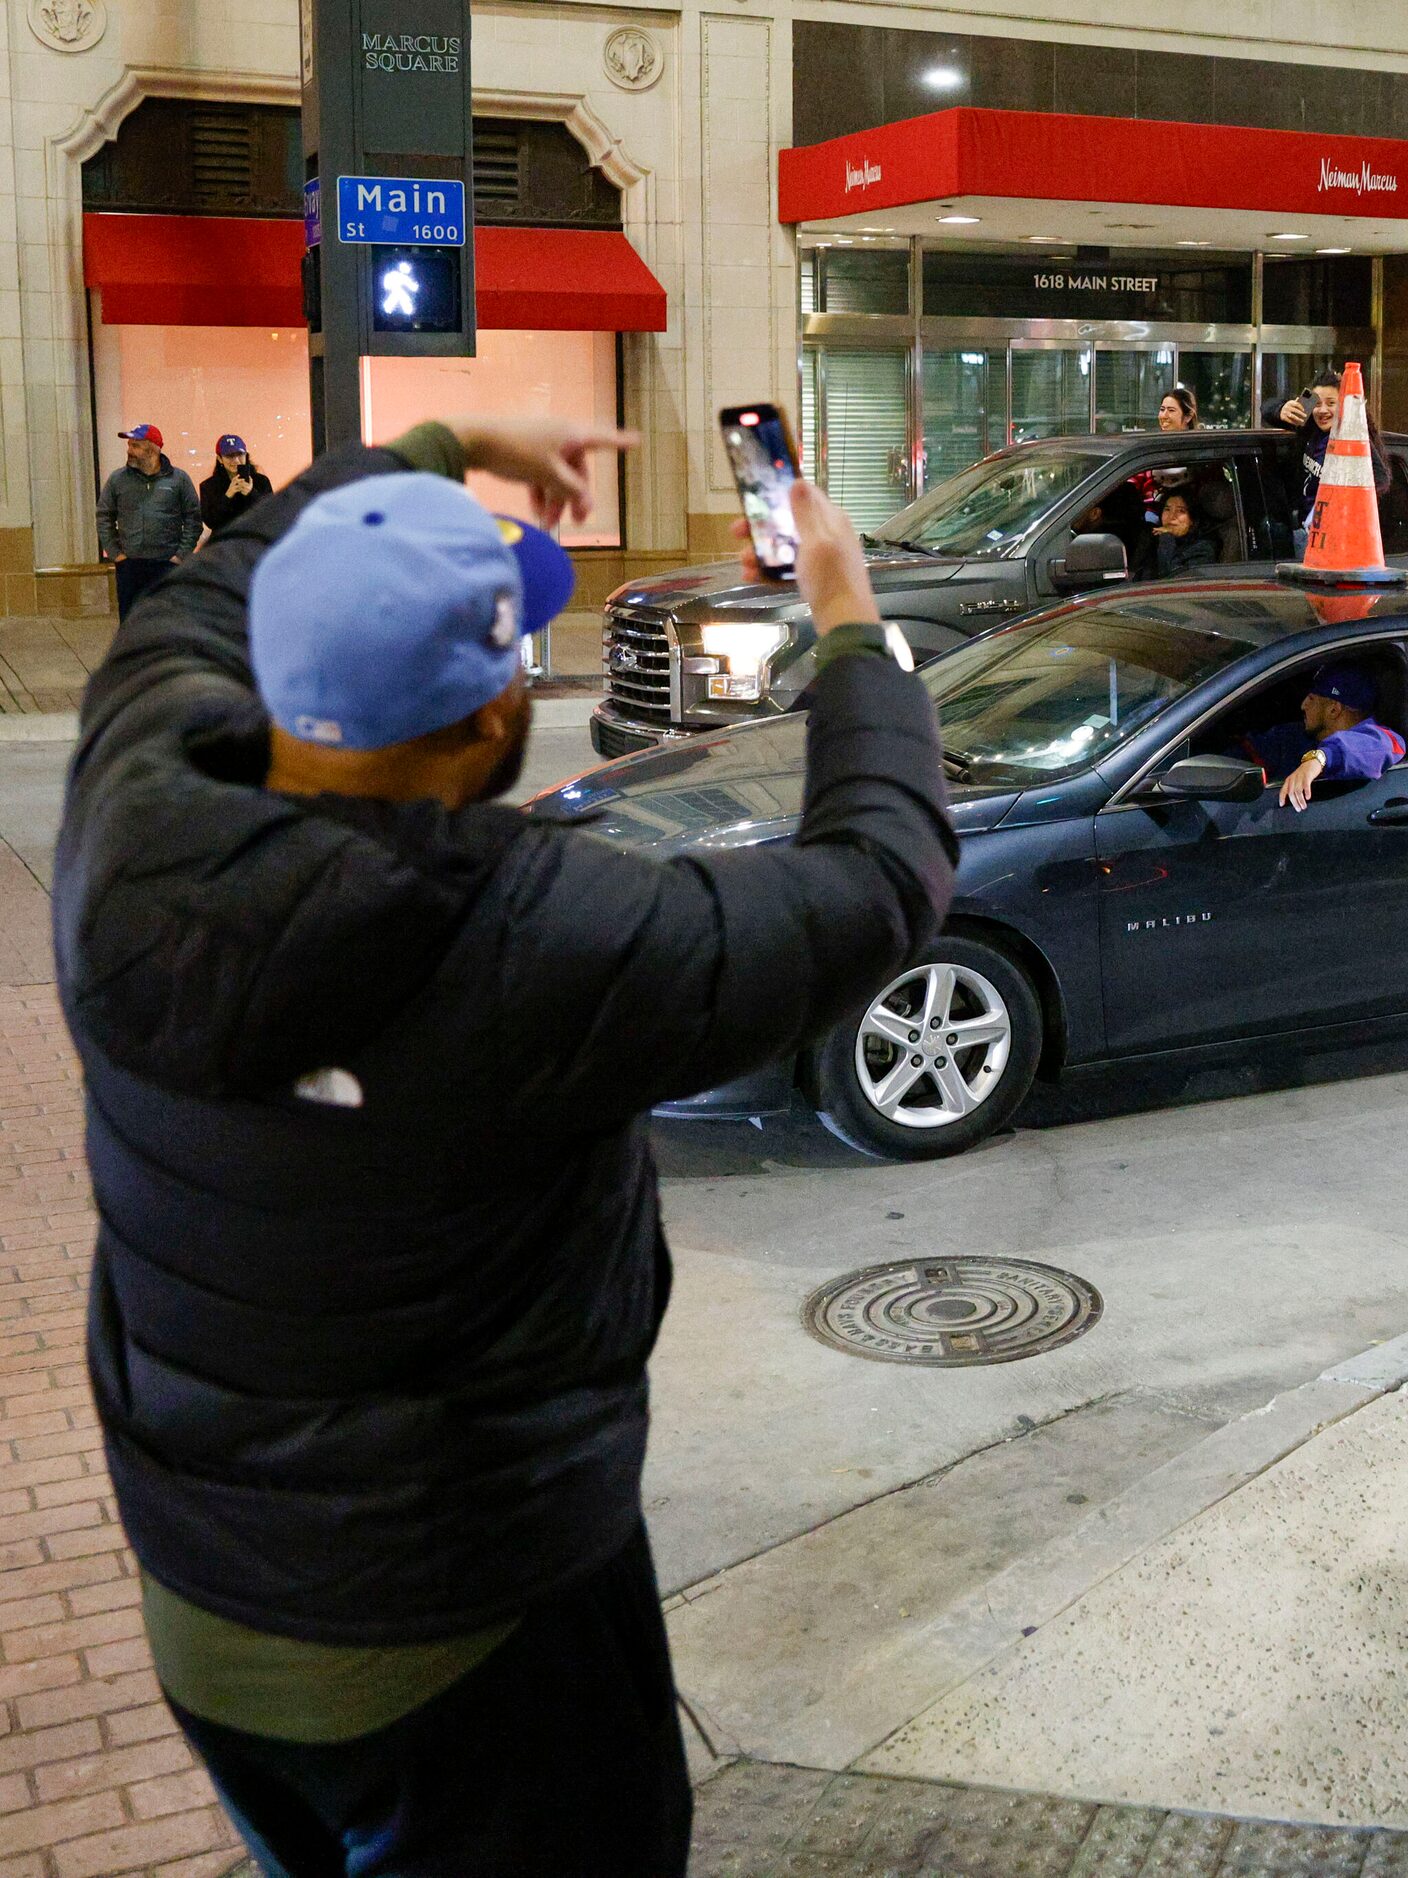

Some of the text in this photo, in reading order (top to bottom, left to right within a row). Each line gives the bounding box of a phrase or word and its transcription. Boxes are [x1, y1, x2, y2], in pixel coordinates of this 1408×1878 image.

[362, 33, 461, 54] MARCUS
[366, 52, 460, 73] SQUARE
[1317, 157, 1398, 196] Neiman Marcus
[357, 184, 446, 214] Main
[346, 222, 458, 241] St 1600
[1033, 274, 1158, 292] 1618 MAIN STREET
[227, 438, 235, 446] T
[1127, 912, 1211, 931] MALIBU
[997, 1272, 1063, 1304] SANITARY
